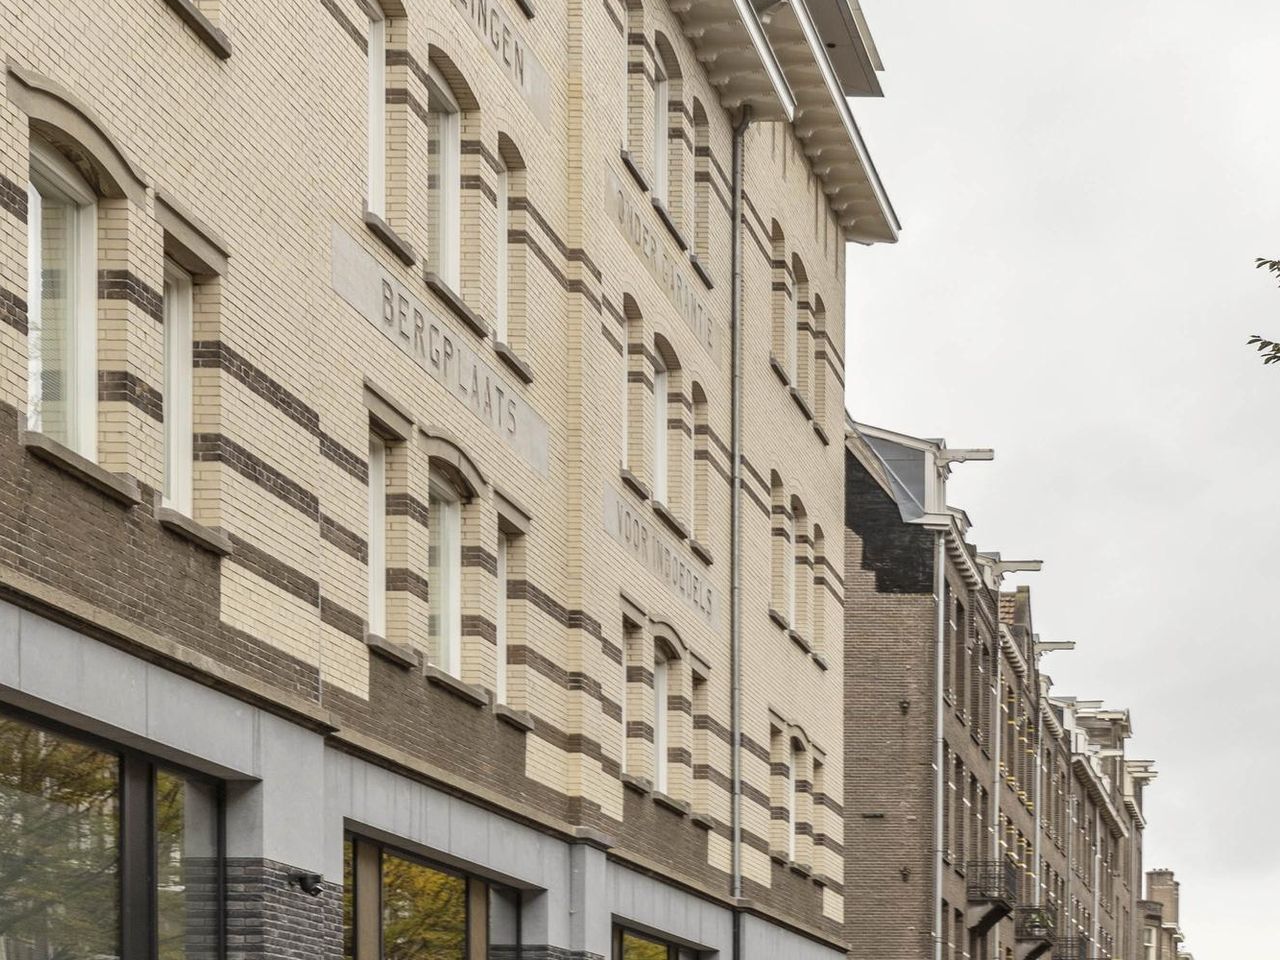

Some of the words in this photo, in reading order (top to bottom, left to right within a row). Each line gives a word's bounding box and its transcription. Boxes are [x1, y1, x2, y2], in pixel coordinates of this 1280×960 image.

[618, 190, 658, 272] ONDER
[382, 278, 517, 433] BERGPLAATS
[617, 500, 649, 563] VOOR
